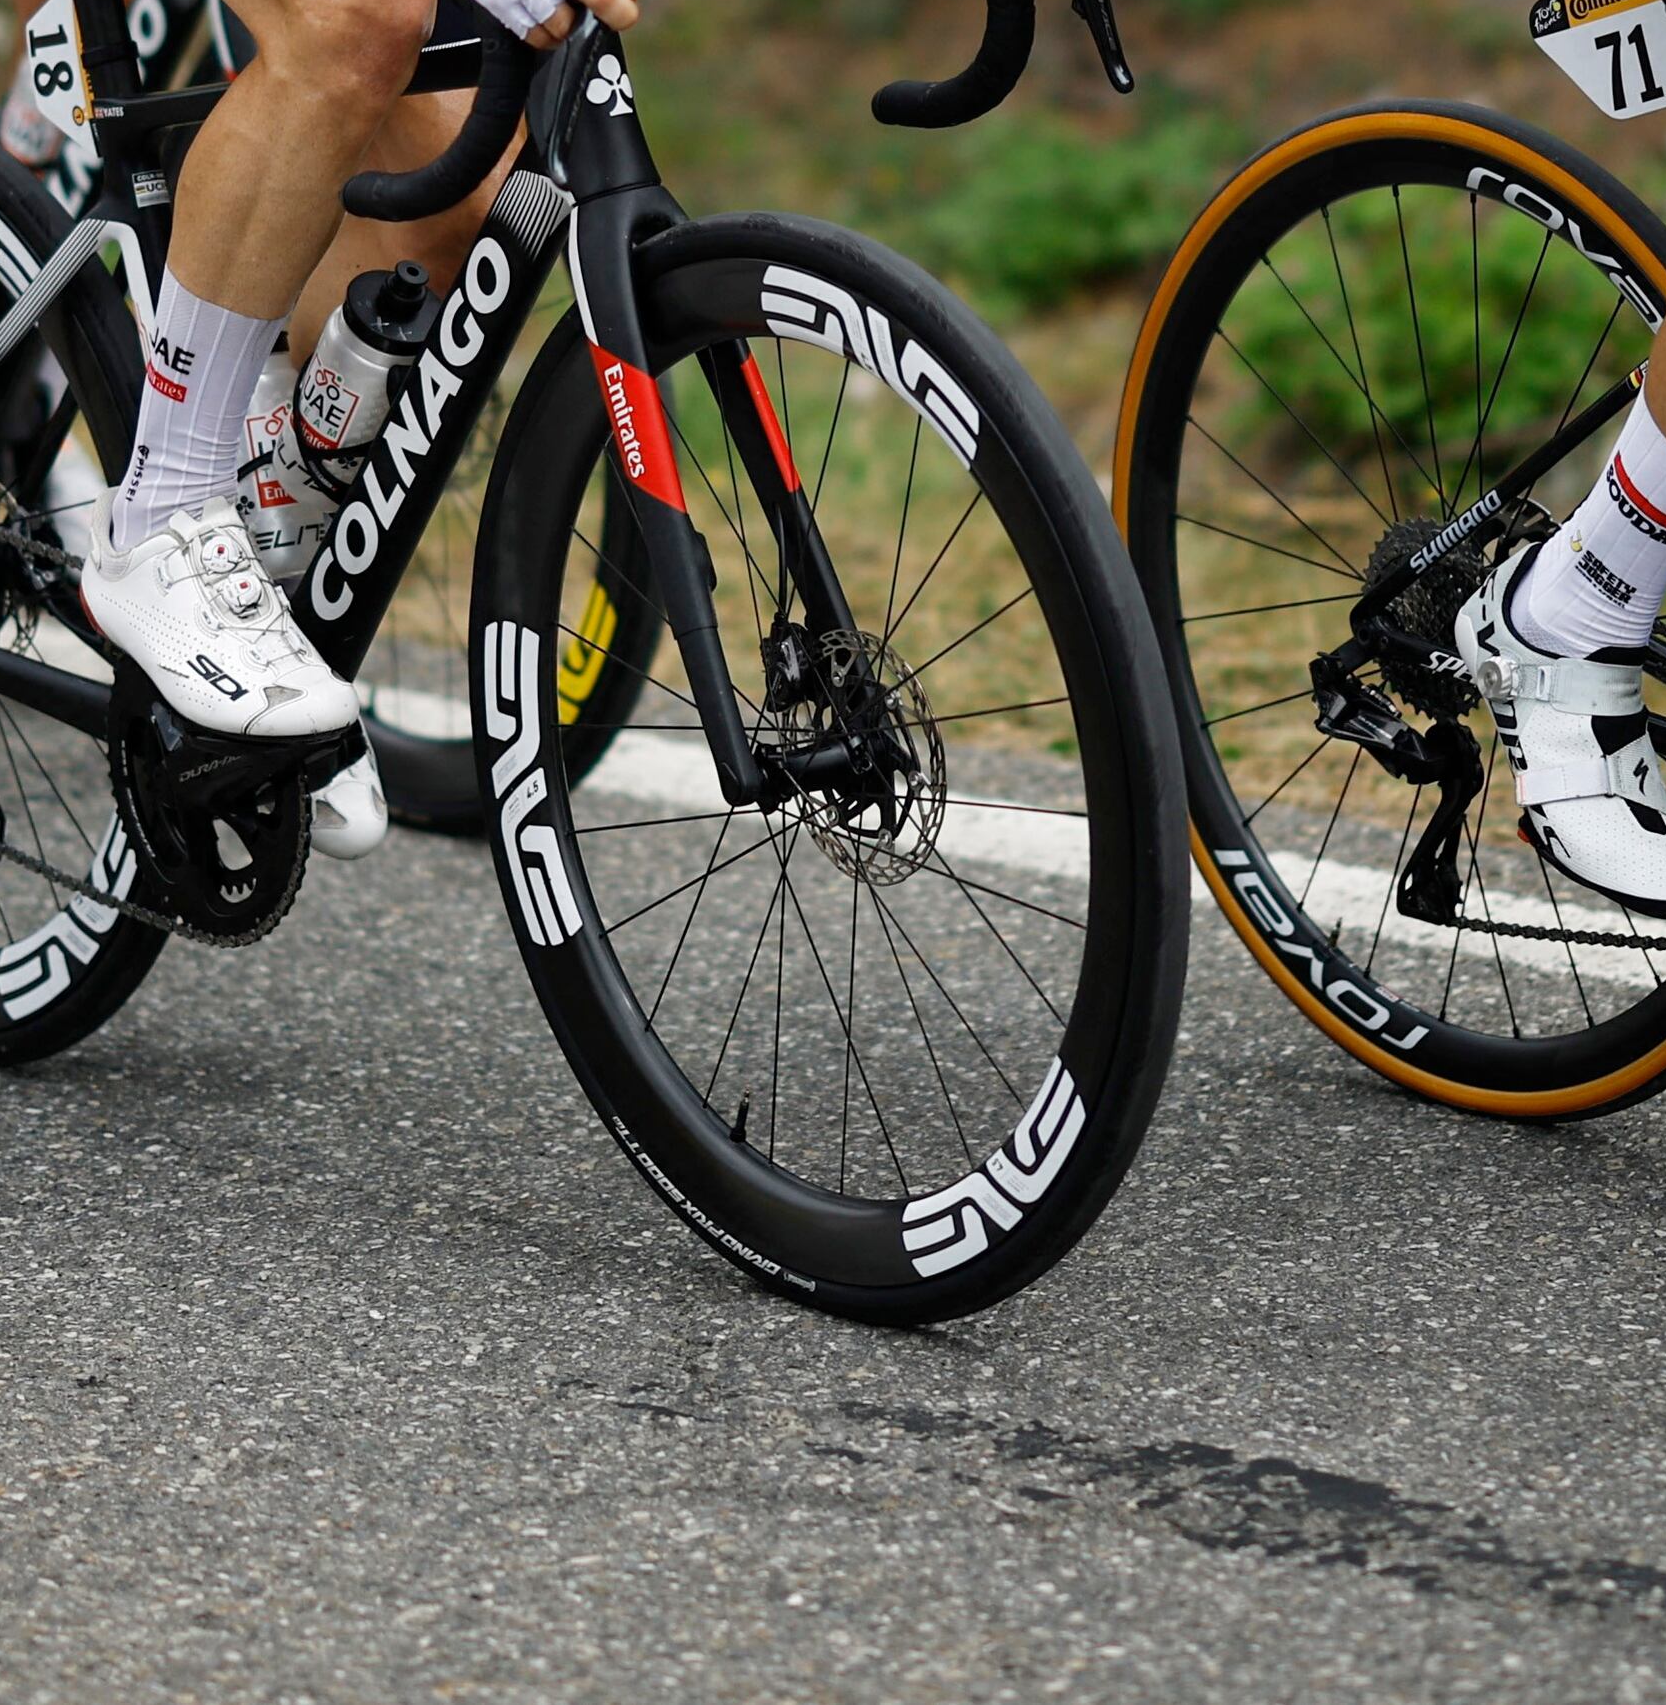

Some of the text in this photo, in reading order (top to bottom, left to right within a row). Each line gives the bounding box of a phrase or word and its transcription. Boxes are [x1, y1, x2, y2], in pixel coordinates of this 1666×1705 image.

[28, 24, 75, 98] 18
[1594, 23, 1665, 111] 71
[103, 106, 126, 119] YATES
[1466, 166, 1664, 336] rova
[310, 236, 511, 622] COLNAGO
[602, 362, 645, 479] Emirates
[125, 458, 145, 502] PISSEI
[1408, 489, 1504, 576] SHIMANO
[1577, 560, 1633, 605] JOGGER
[1581, 549, 1638, 595] SAFETY
[186, 653, 251, 703] SIDI
[1212, 849, 1430, 1052] roval
[635, 1151, 686, 1204] 5000
[680, 1199, 725, 1239] PRIX
[719, 1233, 782, 1276] GRAND
